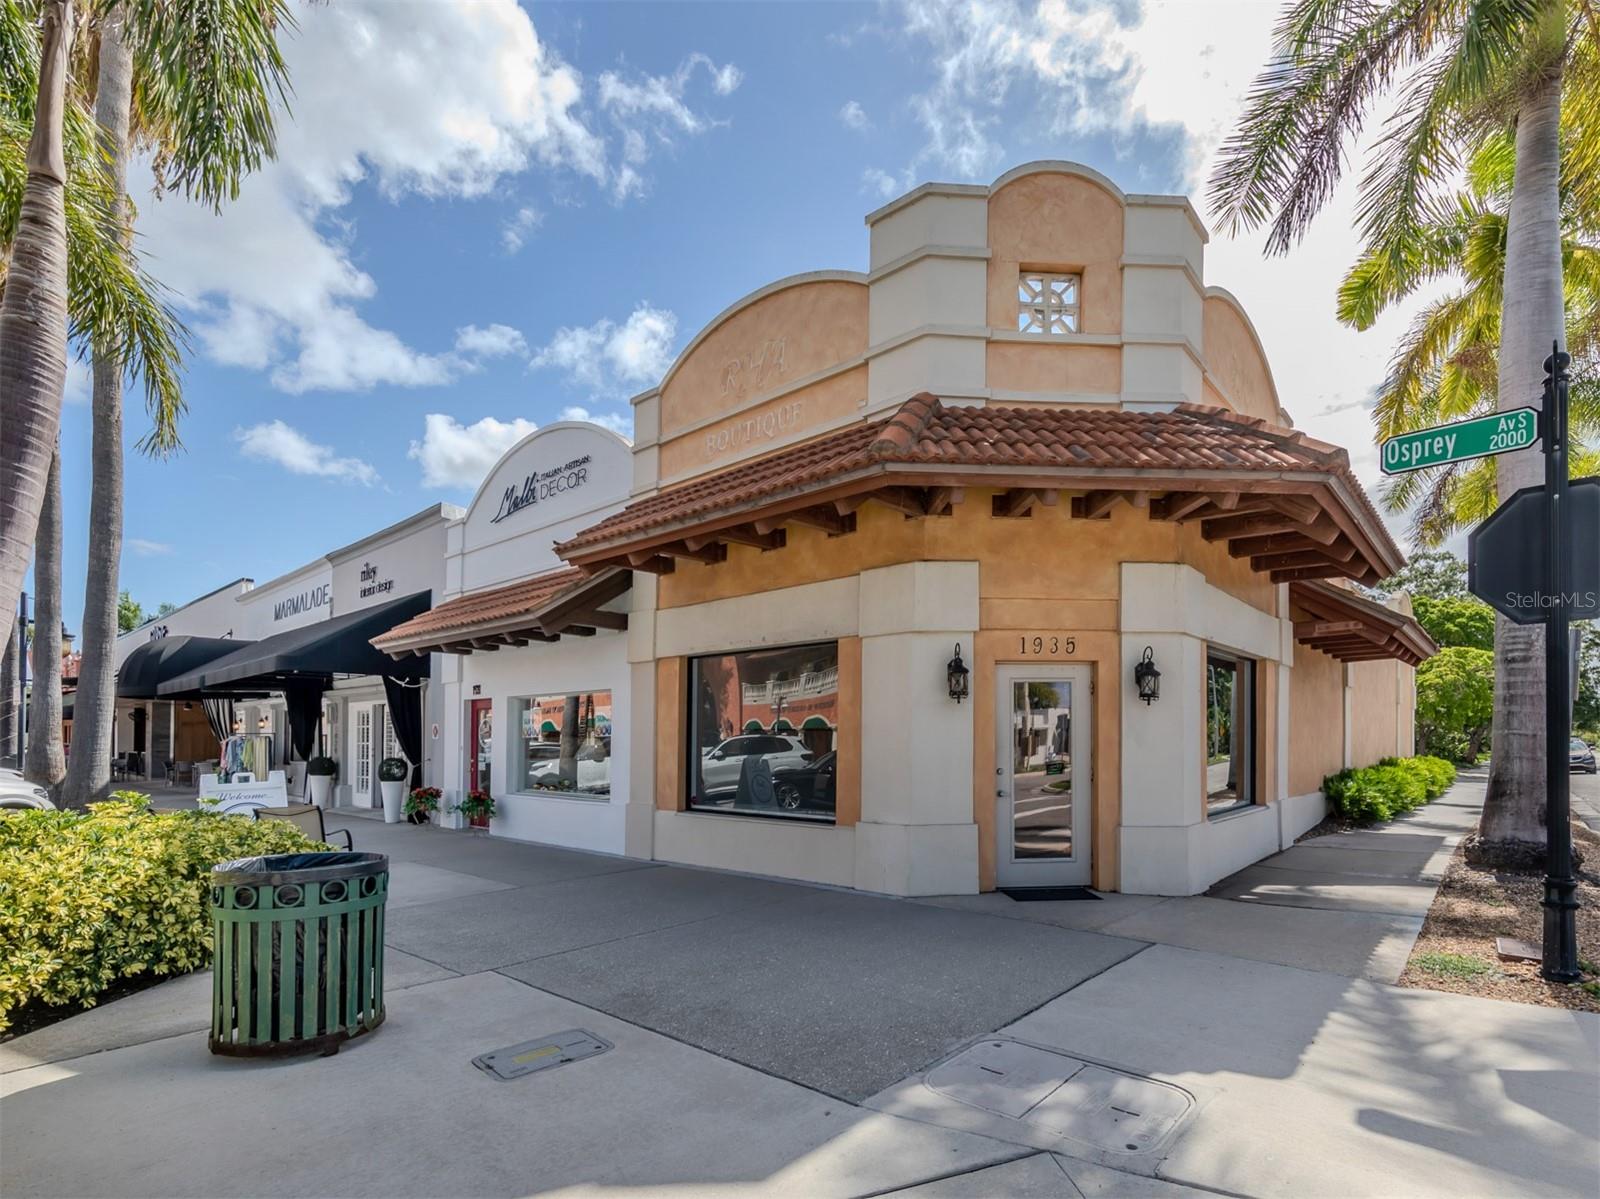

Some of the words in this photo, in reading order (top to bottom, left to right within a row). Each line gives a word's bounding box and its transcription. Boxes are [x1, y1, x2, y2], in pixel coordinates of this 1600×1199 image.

[705, 401, 804, 455] BOUTIQUE
[1498, 418, 1515, 432] Av
[1518, 412, 1527, 428] S
[1386, 433, 1457, 465] Osprey
[1489, 428, 1527, 449] 2000
[540, 467, 587, 500] DECOR
[273, 583, 330, 621] MARMALADE
[1020, 636, 1076, 655] 1935
[217, 792, 268, 801] Welcome
